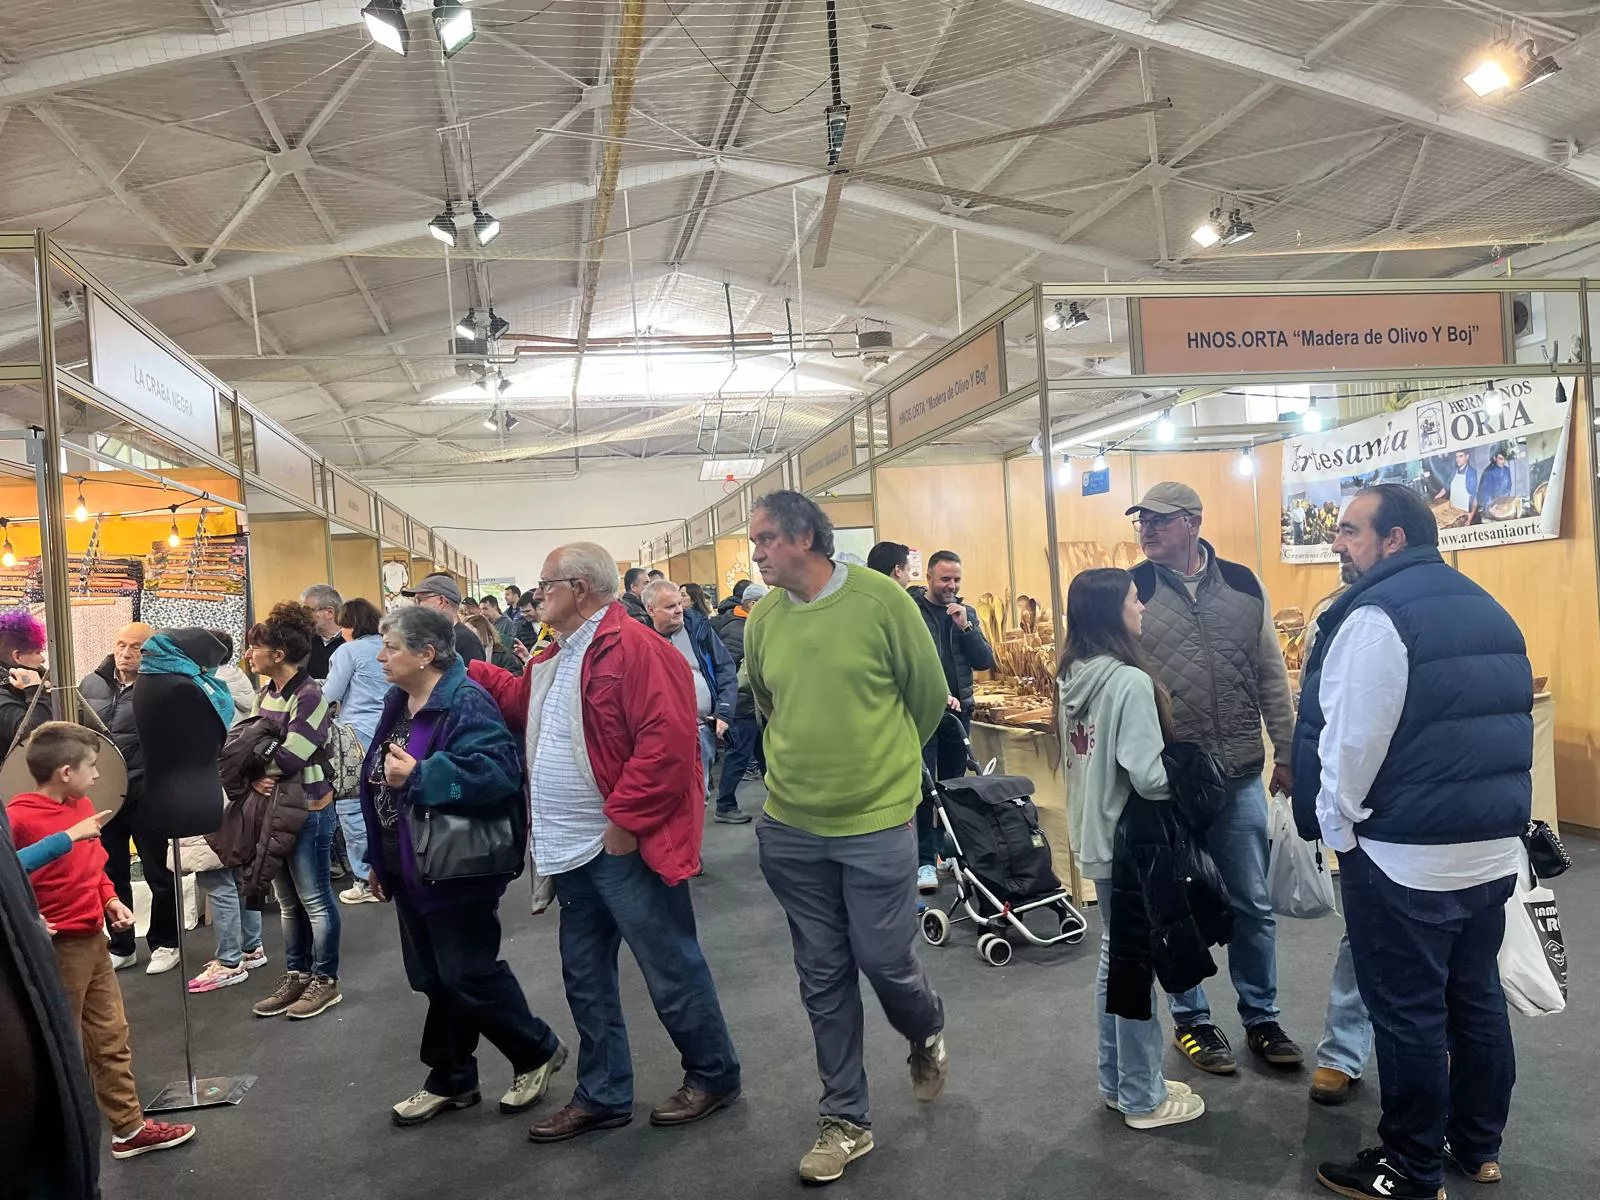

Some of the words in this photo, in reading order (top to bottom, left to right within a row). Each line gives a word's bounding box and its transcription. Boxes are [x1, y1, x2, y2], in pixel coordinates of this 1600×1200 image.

[1187, 330, 1288, 349] HNOS.ORTA
[1364, 328, 1383, 345] de
[1387, 327, 1428, 344] Olivo
[1432, 326, 1442, 342] Y
[134, 364, 145, 388] LA
[171, 389, 195, 419] NEGRA
[954, 379, 970, 396] Olivo
[970, 373, 975, 388] Y
[1448, 380, 1532, 413] HERMNOS
[1451, 399, 1534, 441] ORTA
